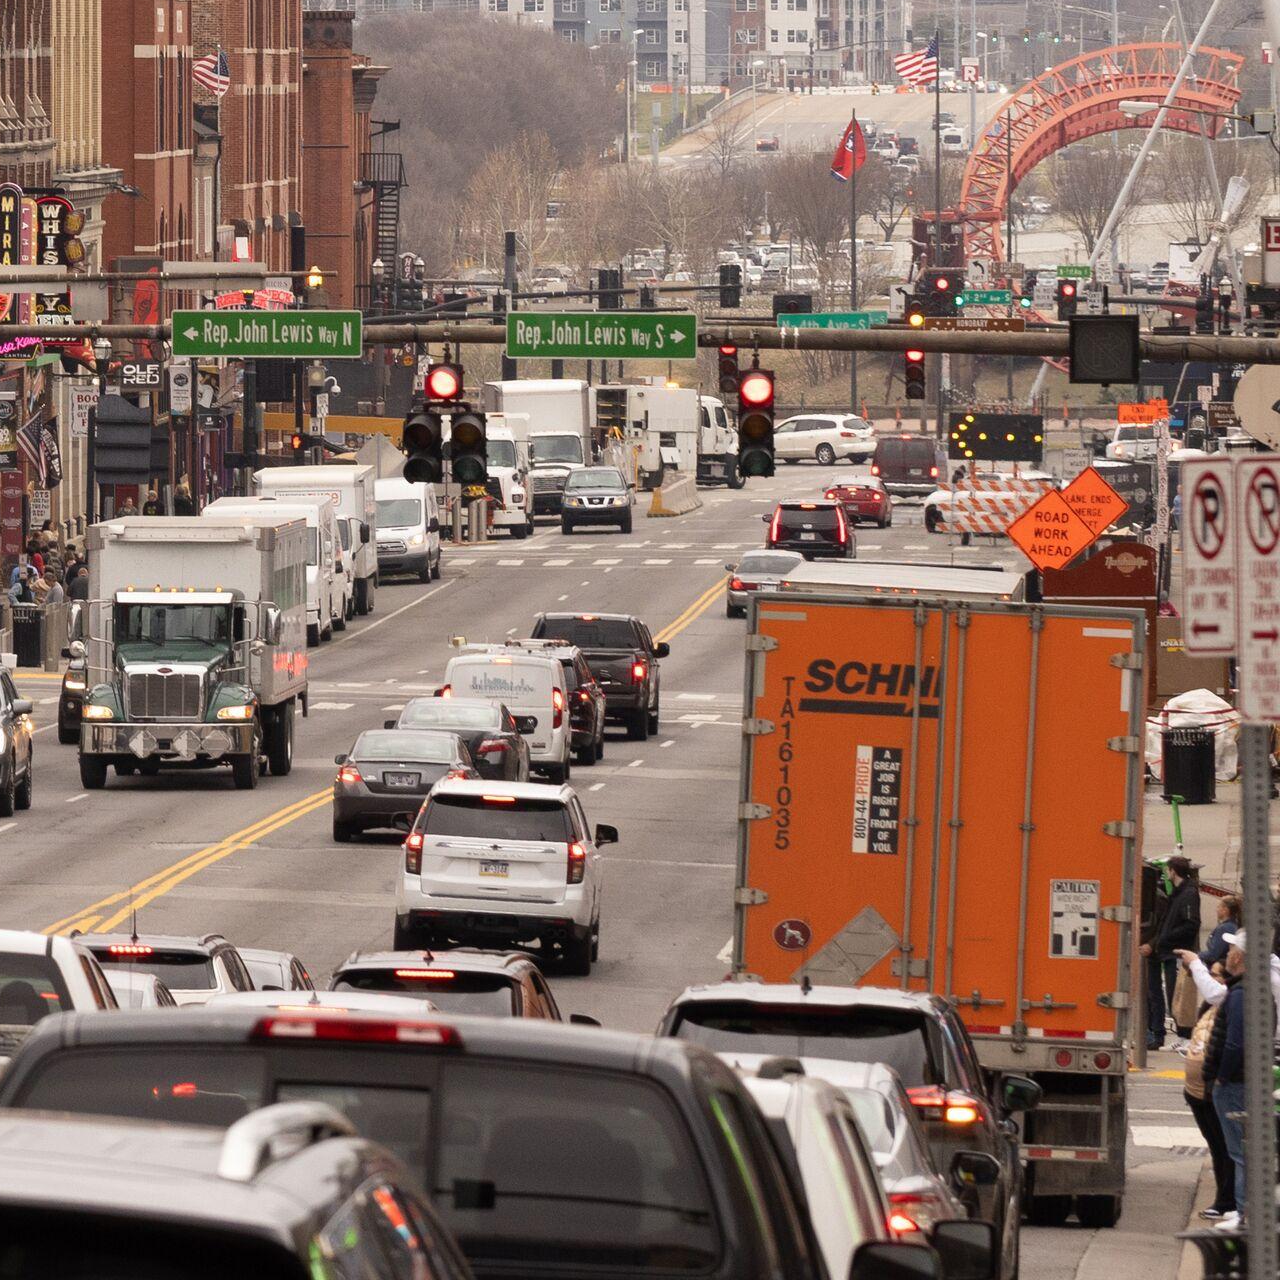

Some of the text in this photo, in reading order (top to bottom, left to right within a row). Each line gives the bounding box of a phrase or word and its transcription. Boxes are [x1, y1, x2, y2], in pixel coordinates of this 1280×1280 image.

[203, 318, 352, 348] Rep. John Lewis Way N
[516, 320, 665, 350] Rep. John Lewis Way S
[122, 364, 160, 376] OLE
[122, 374, 160, 385] RED
[1065, 495, 1112, 504] LANE ENDS
[1034, 511, 1069, 524] ROAD
[1075, 508, 1103, 517] MERGE
[1033, 529, 1069, 541] WORK
[1029, 544, 1072, 557] AHEAD
[883, 750, 892, 760] A
[773, 676, 796, 851] TA161035
[873, 761, 901, 771] GREAT
[877, 773, 895, 783] JOB
[881, 784, 890, 794] IS
[854, 756, 871, 840] 800-44-PRIDE
[872, 795, 899, 806] RIGHT
[879, 807, 890, 817] IN
[869, 819, 898, 829] FRONT
[877, 831, 890, 841] OF
[871, 842, 893, 853] YOU.
[1052, 881, 1097, 894] CAUTION
[1056, 894, 1091, 904] WIDE RIGHT
